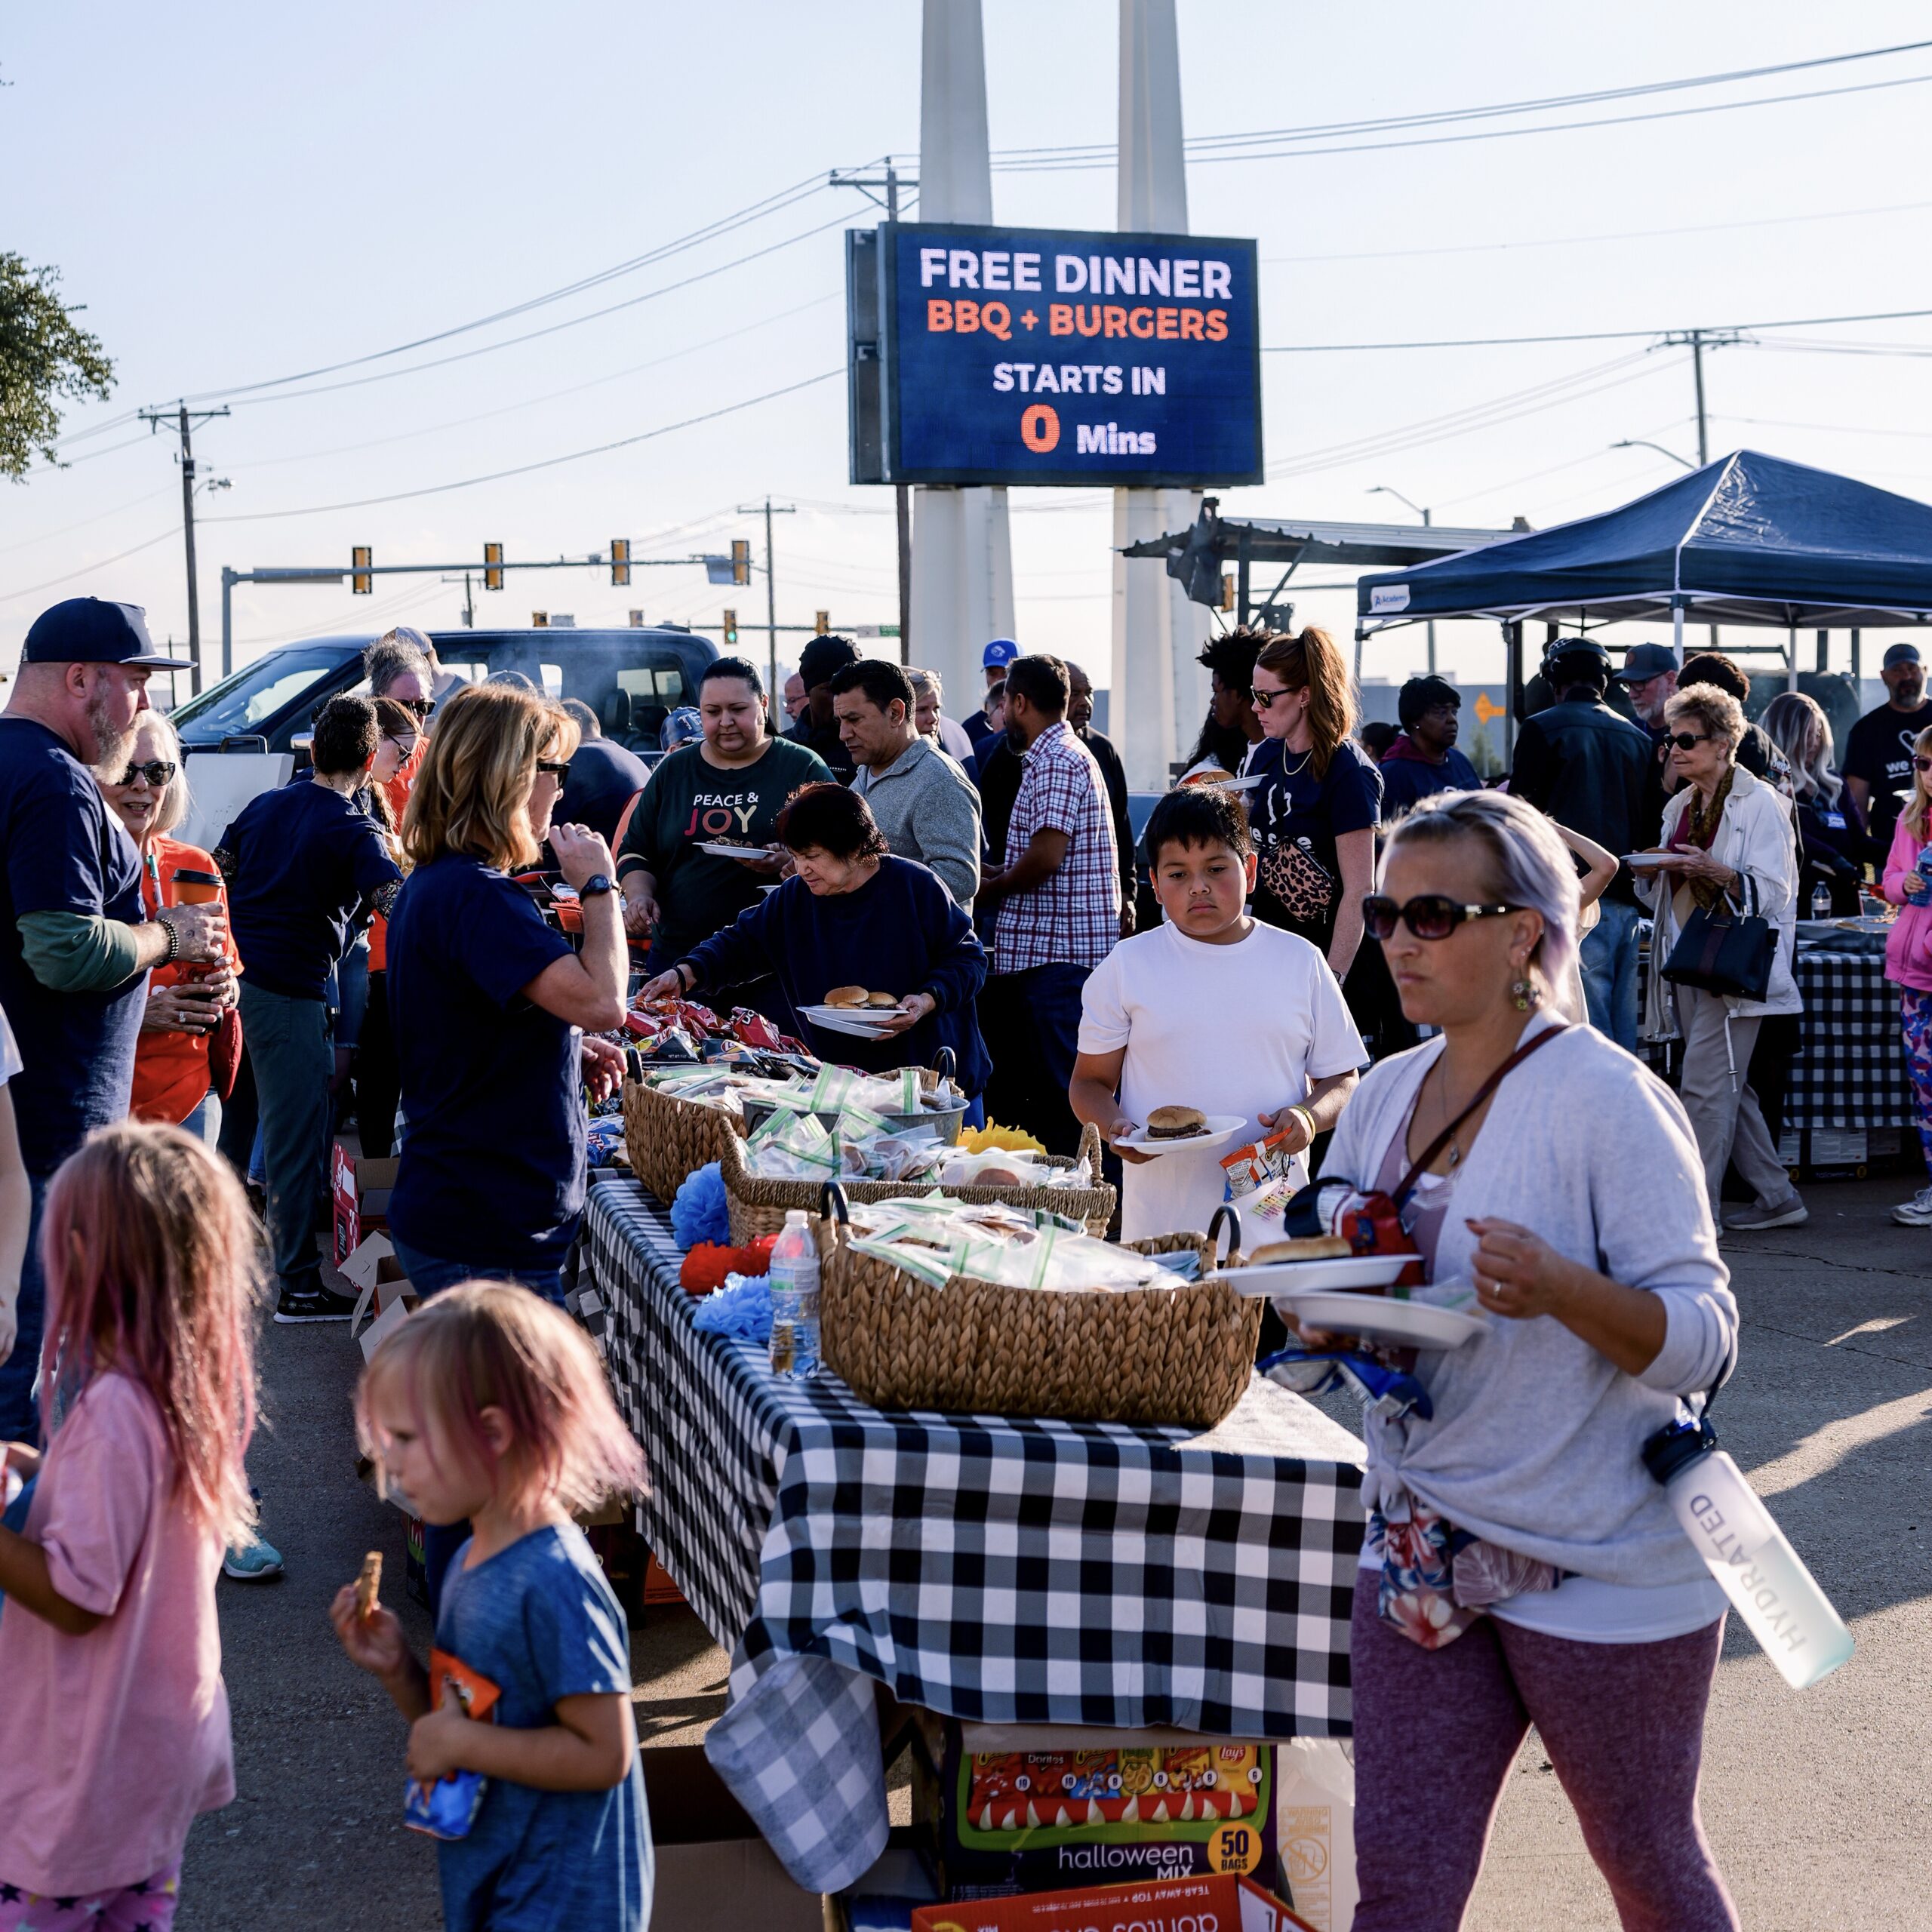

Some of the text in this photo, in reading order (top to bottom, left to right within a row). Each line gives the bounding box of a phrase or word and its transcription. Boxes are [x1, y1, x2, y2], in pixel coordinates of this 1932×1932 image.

[920, 248, 1232, 299] FREE DINNER
[928, 300, 1229, 342] BBQ + BURGERS
[992, 362, 1166, 395] STARTS IN
[1021, 404, 1156, 454] 0 Mins
[1886, 761, 1909, 773] we
[693, 792, 759, 807] PEACE &
[685, 804, 757, 836] JOY
[1690, 1494, 1808, 1652] HYDRATED
[1028, 1754, 1064, 1764] Doritos
[1220, 1746, 1244, 1761] Lay's
[1221, 1830, 1249, 1857] 50
[1059, 1844, 1194, 1869] halloween
[1221, 1858, 1247, 1871] BAGS
[1157, 1865, 1192, 1881] MIX
[1132, 1884, 1210, 1903] TEAR-AWAY TOP
